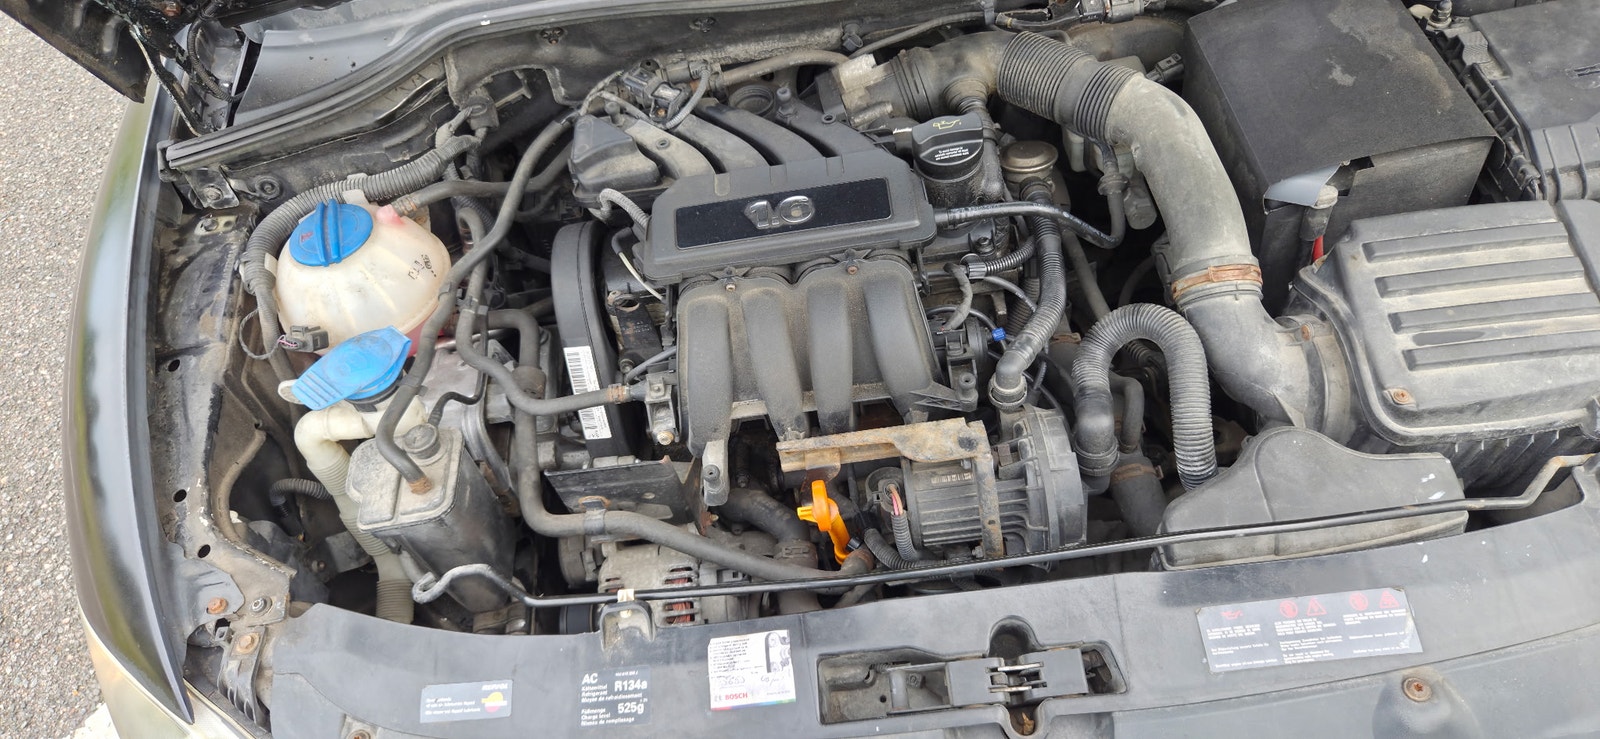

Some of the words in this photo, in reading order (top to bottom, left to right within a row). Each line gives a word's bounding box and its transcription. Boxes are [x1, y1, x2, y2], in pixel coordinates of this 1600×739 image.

[745, 195, 815, 229] 1.6
[581, 672, 598, 685] AC
[614, 679, 648, 692] R134a
[725, 692, 748, 700] BOSCH
[617, 702, 645, 715] 525g
